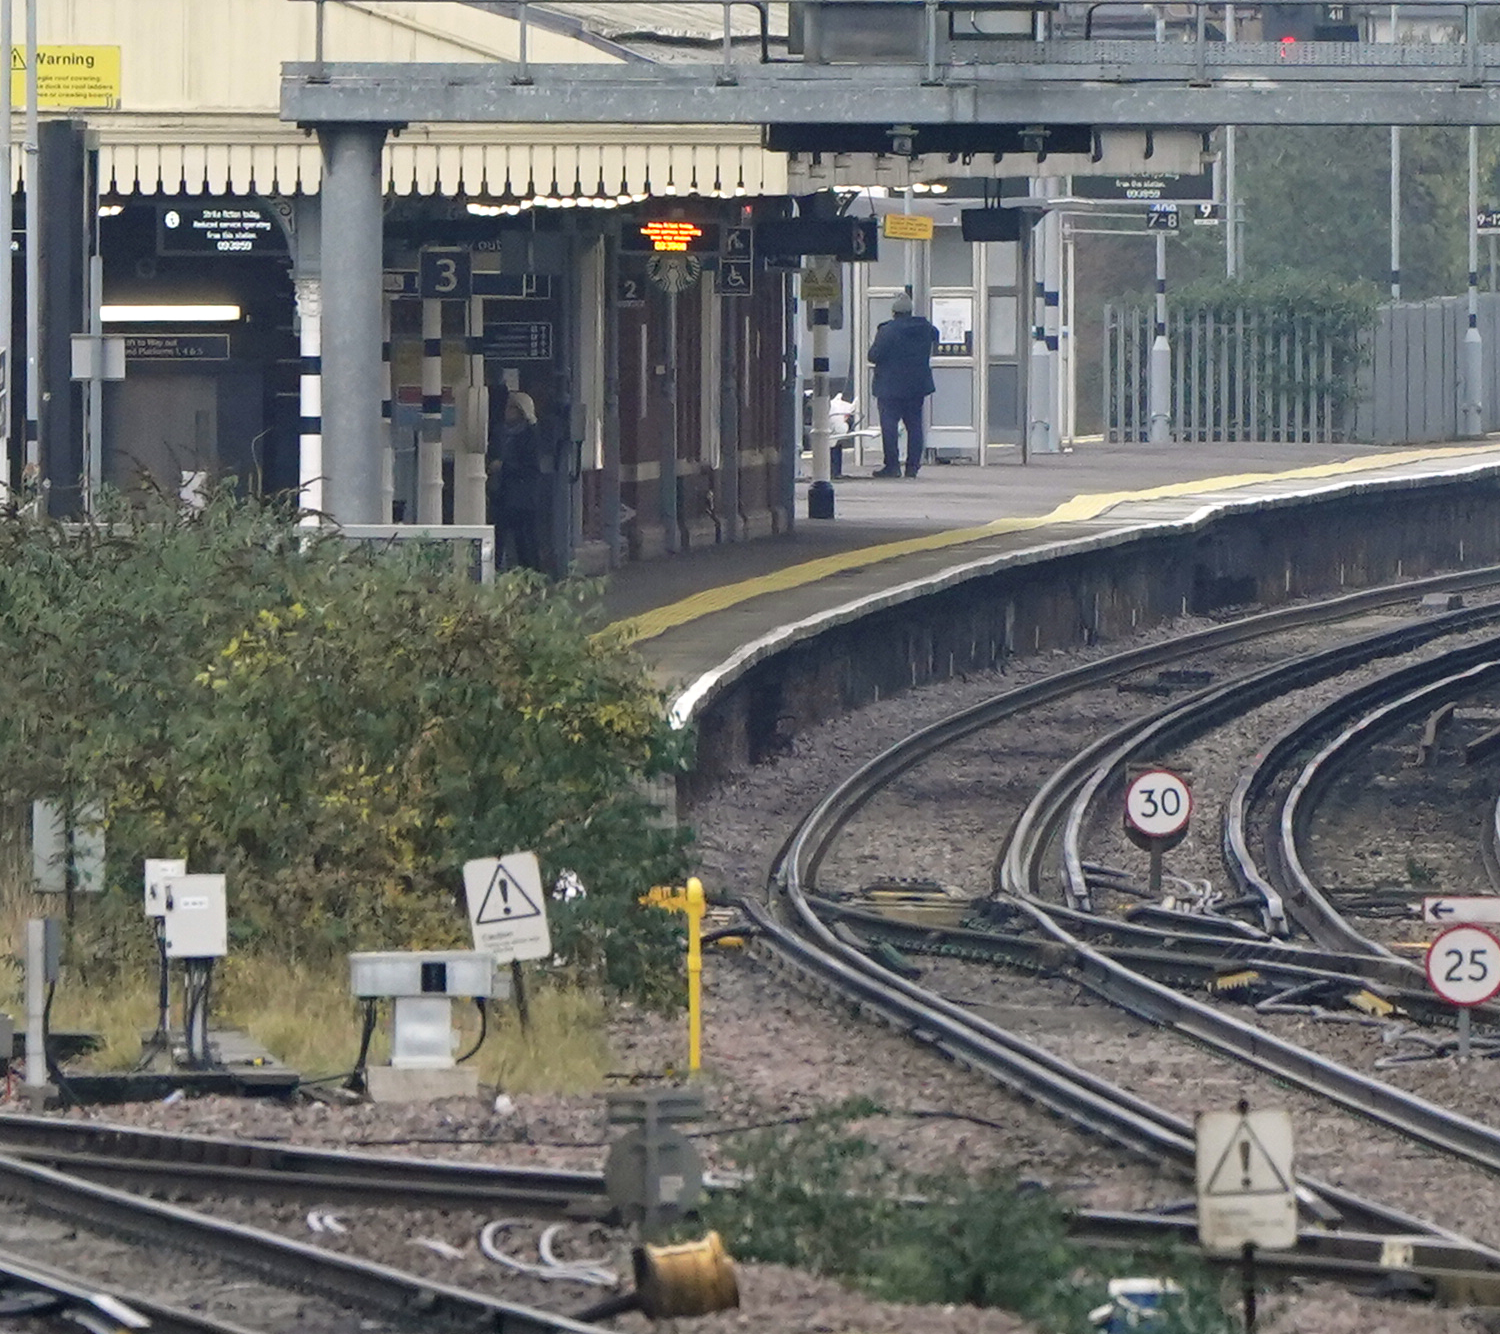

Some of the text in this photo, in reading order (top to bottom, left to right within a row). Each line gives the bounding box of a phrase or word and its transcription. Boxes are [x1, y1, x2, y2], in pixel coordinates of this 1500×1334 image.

[35, 52, 95, 68] Warning
[1148, 213, 1178, 228] 7-8
[1200, 204, 1212, 218] 9
[434, 258, 459, 292] 3
[1138, 788, 1181, 818] 30
[1444, 949, 1489, 983] 25
